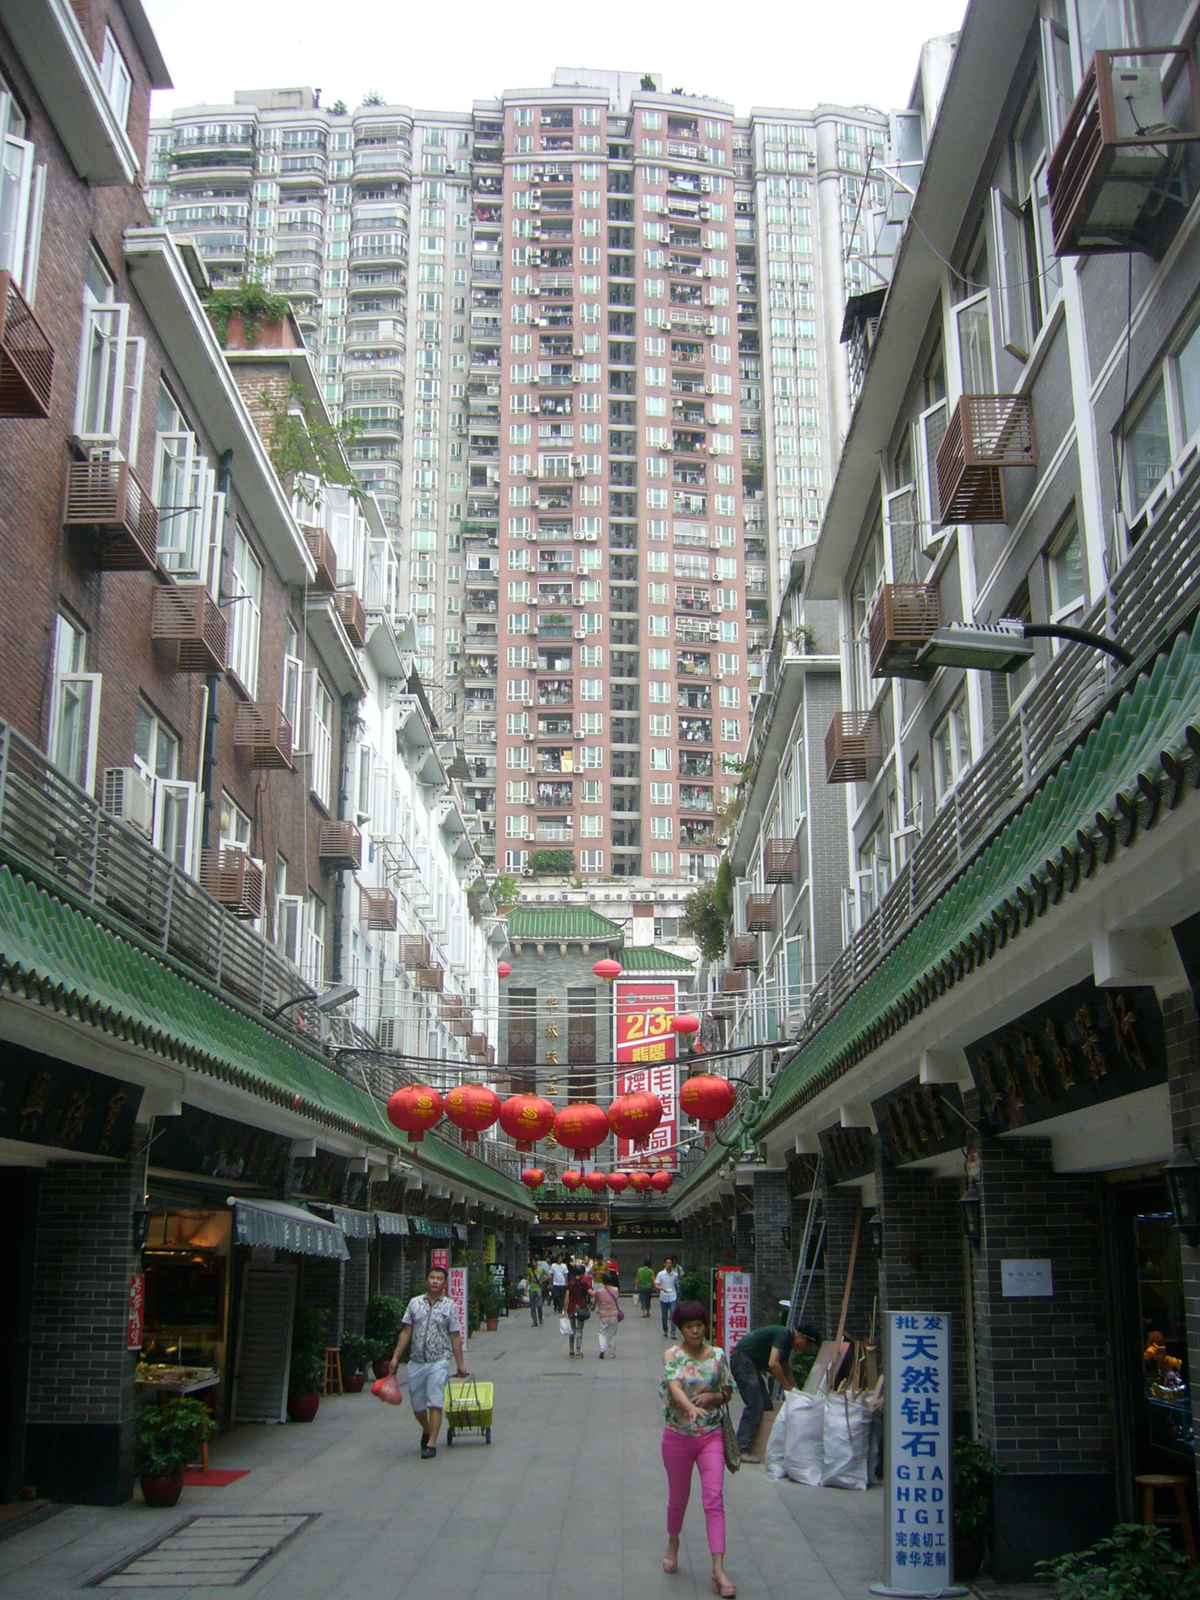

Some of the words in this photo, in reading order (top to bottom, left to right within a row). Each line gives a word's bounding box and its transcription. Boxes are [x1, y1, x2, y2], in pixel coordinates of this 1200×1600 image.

[895, 1315, 944, 1331] 批发
[901, 1334, 940, 1458] 天然钻石
[896, 1465, 944, 1481] GIA
[896, 1487, 944, 1503] HRD
[896, 1508, 945, 1525] IGI
[895, 1531, 946, 1547] 完美切工
[895, 1551, 947, 1567] 奢华定制
